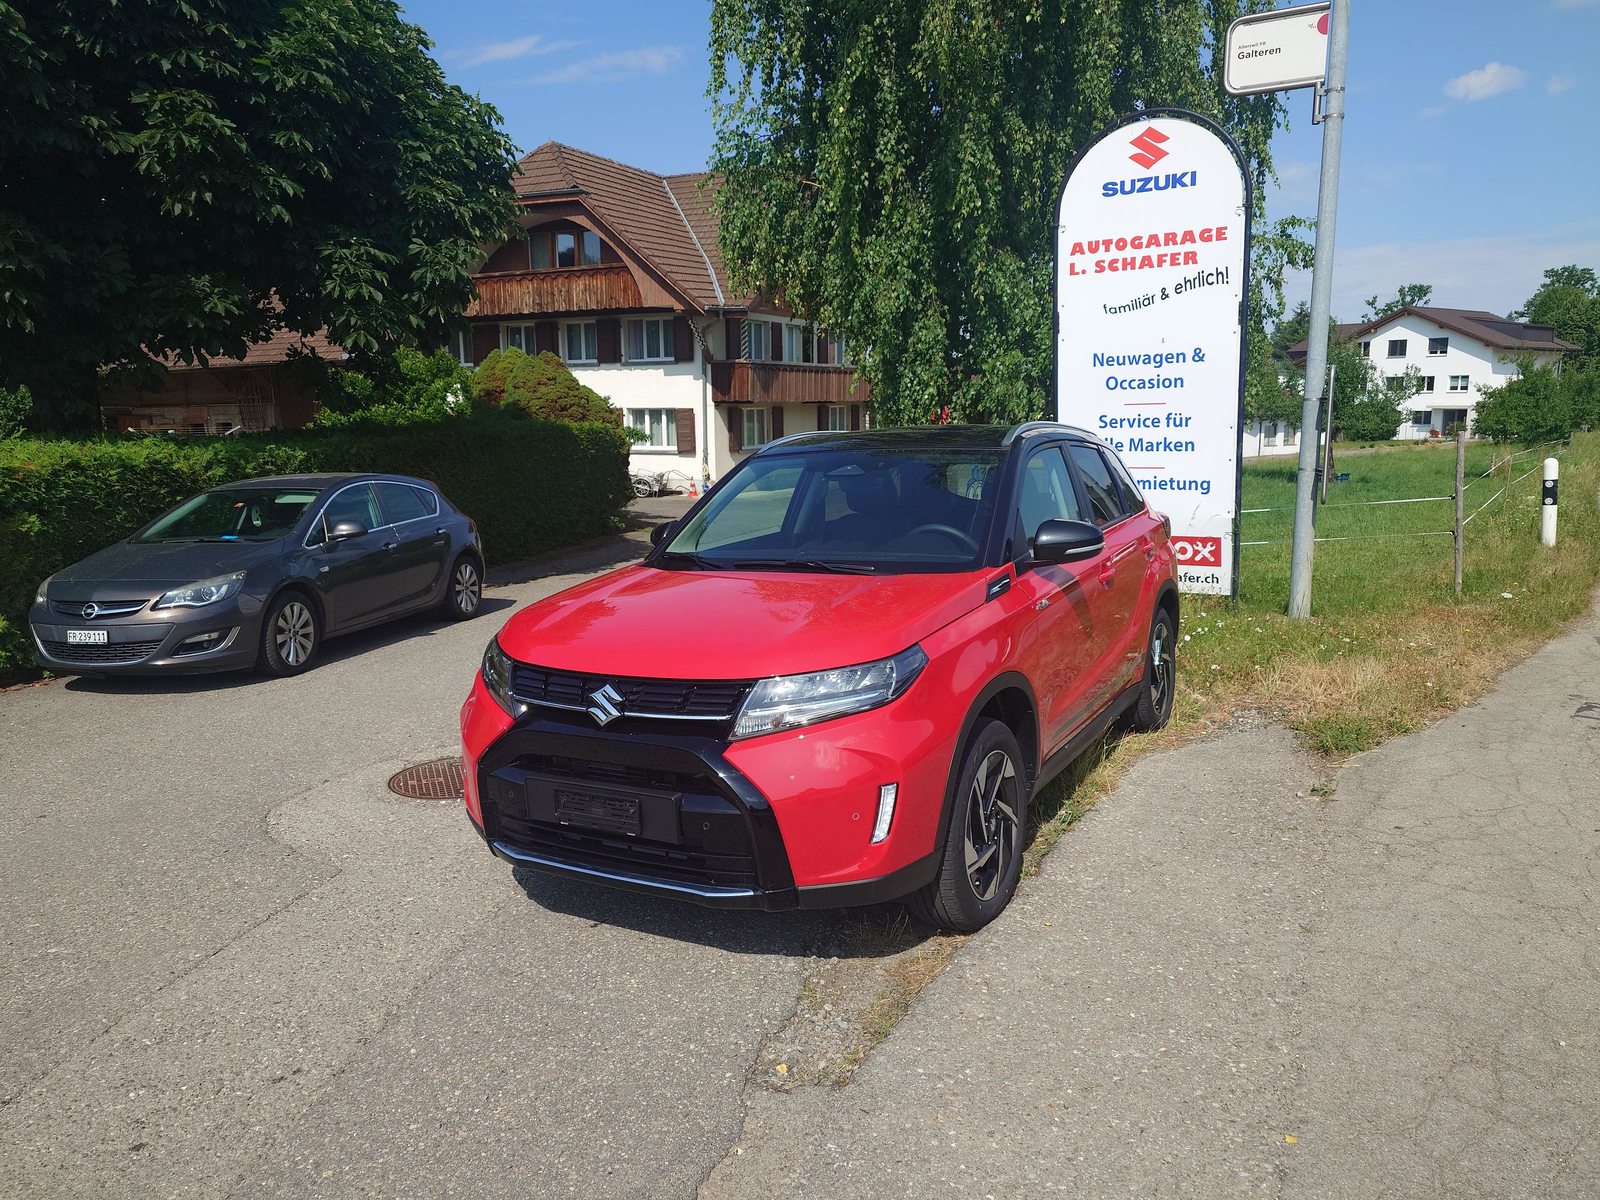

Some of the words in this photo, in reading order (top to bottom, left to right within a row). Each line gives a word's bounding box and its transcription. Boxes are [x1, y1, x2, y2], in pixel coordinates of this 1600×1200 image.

[1238, 47, 1281, 60] Galteren
[1102, 170, 1197, 197] SUZUKI
[1070, 226, 1228, 256] AUTOGARAGE
[1069, 262, 1087, 276] L.
[1103, 294, 1156, 315] familiär
[1160, 287, 1170, 301] &
[1174, 266, 1229, 294] ehrlich!
[1093, 350, 1187, 369] Neuwagen
[1192, 347, 1205, 363] &
[1105, 374, 1185, 391] Occasion
[1099, 414, 1161, 429] Service
[1166, 412, 1191, 428] für
[1129, 437, 1195, 453] Marken
